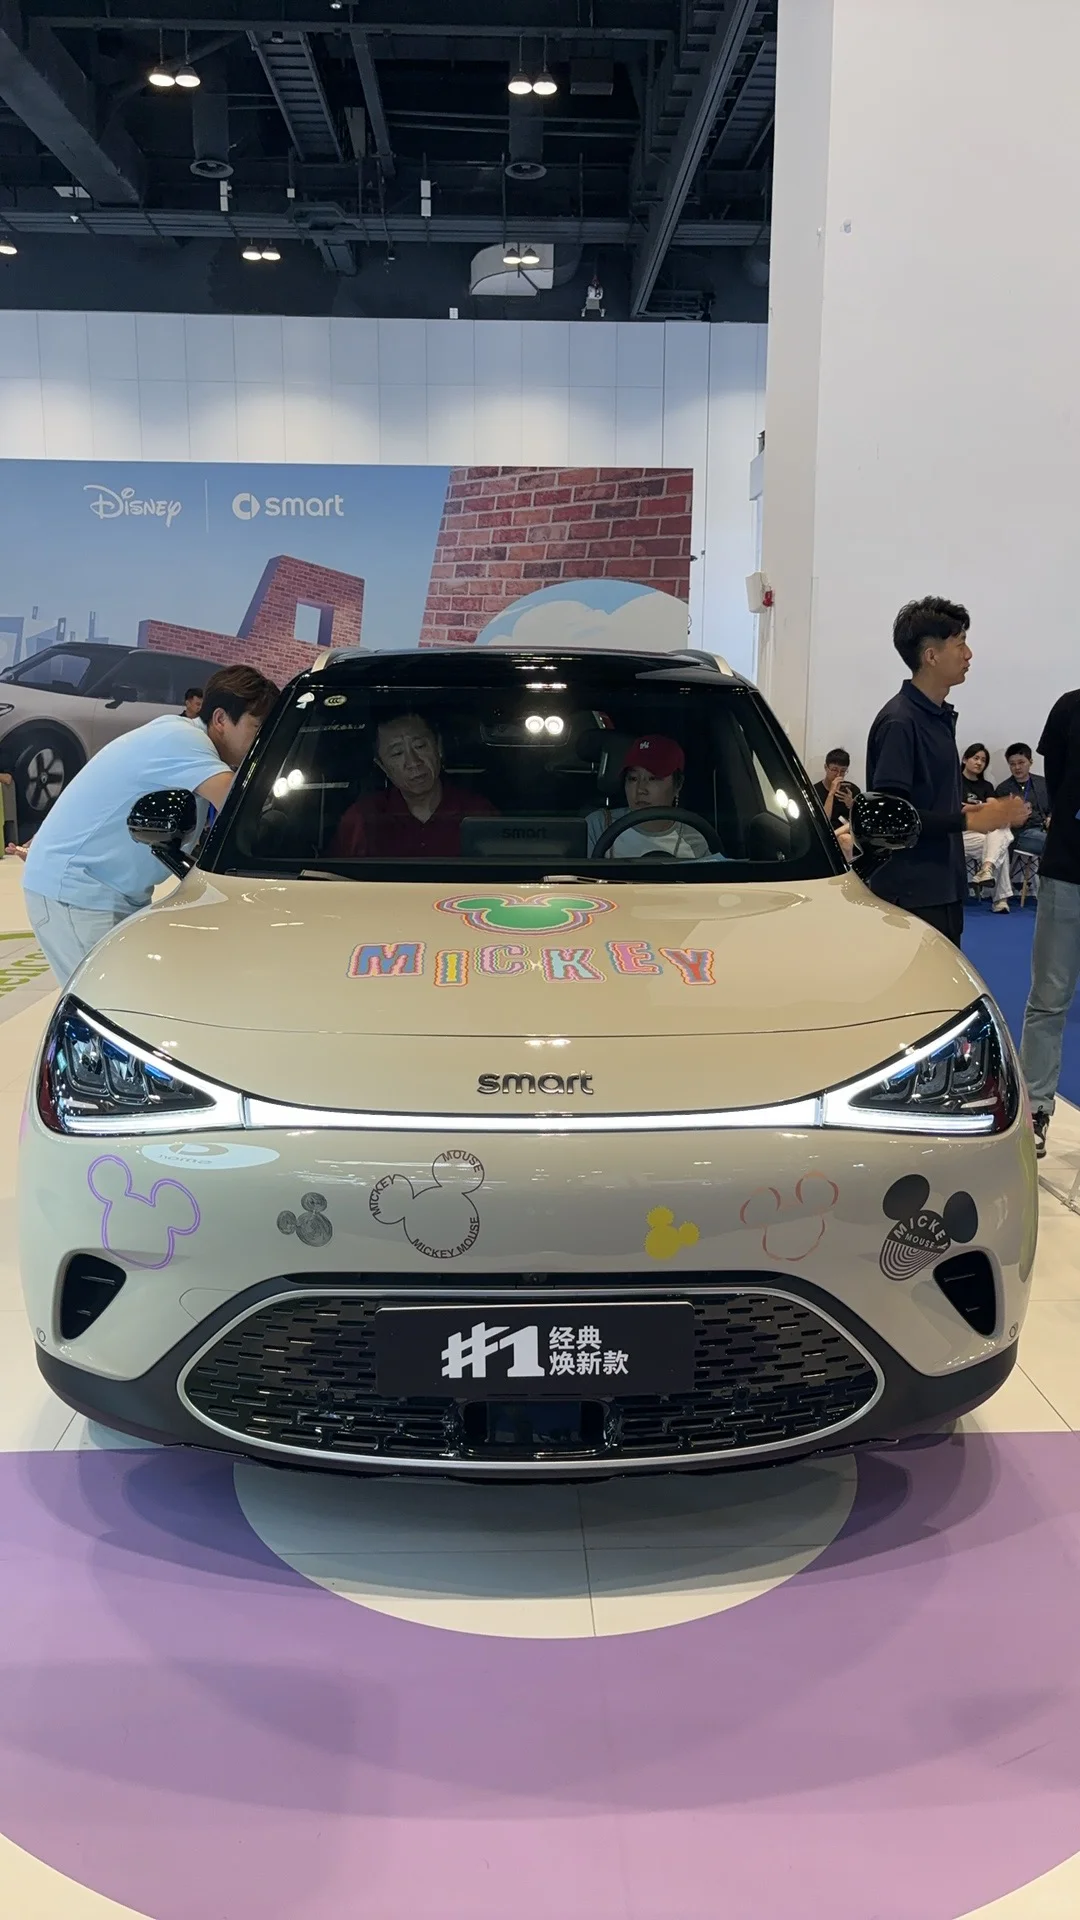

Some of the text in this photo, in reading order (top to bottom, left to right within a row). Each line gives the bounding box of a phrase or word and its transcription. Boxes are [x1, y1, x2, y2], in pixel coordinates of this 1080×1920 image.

[264, 494, 345, 517] smart
[502, 826, 548, 839] smart
[347, 941, 717, 988] MICKEY
[477, 1070, 594, 1095] smart
[441, 1150, 484, 1173] MOUSE
[369, 1174, 396, 1217] MICKEY
[412, 1217, 480, 1259] MICKEY MOUSE
[893, 1215, 949, 1250] MICKEY
[904, 1233, 935, 1249] MOUSE
[441, 1322, 545, 1379] #1
[549, 1326, 602, 1350] 经典
[549, 1350, 629, 1376] 焕新款
